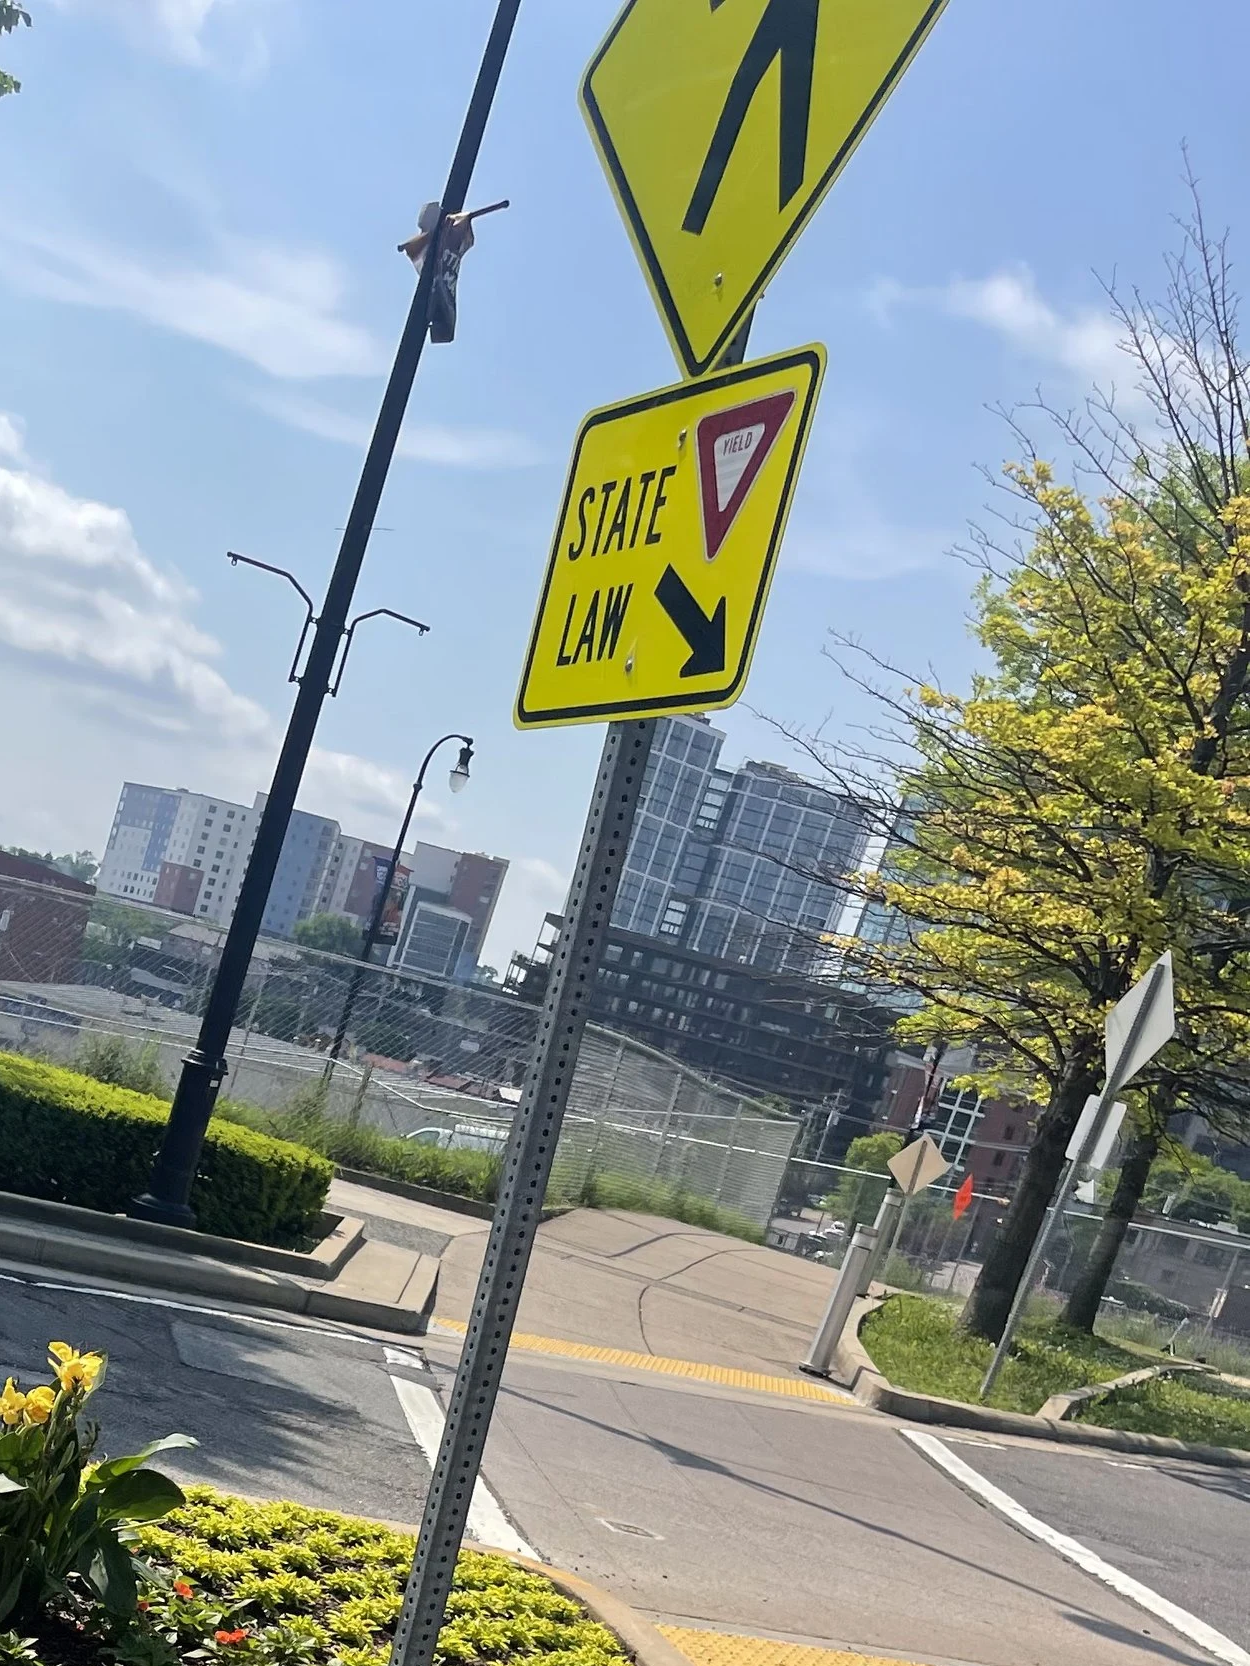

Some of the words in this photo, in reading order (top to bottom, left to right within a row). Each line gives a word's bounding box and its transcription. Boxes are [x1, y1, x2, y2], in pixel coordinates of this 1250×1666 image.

[722, 431, 753, 456] YIELD
[568, 465, 676, 562] STATE
[556, 583, 634, 667] LAW
